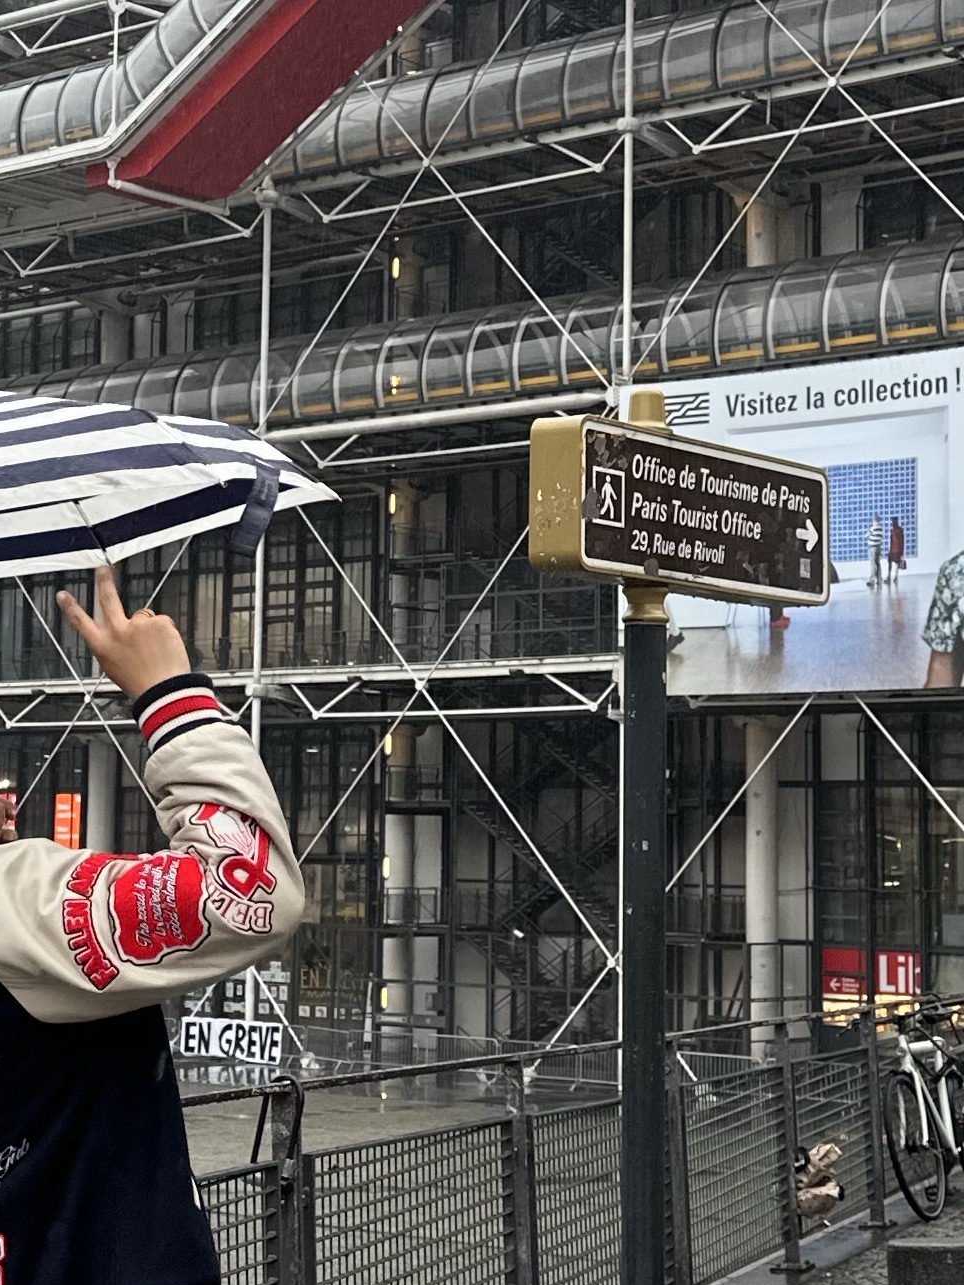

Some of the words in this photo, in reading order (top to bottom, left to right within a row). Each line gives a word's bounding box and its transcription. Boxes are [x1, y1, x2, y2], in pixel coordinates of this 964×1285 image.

[725, 391, 798, 418] Visitez
[806, 386, 825, 410] la
[833, 373, 948, 407] collection
[632, 453, 676, 486] Office
[679, 464, 696, 490] de
[700, 467, 759, 504] Tourisme
[761, 482, 777, 507] de
[779, 485, 810, 514] Paris
[631, 491, 668, 523] Paris
[672, 499, 718, 532] Tourist
[721, 509, 762, 540] Office
[630, 529, 651, 555] 29,
[653, 533, 676, 557] Rue
[677, 538, 692, 559] de
[693, 540, 726, 565] Rivoli
[63, 898, 120, 990] FALLEN
[184, 1021, 211, 1054] EN
[218, 1023, 281, 1063] GREVE
